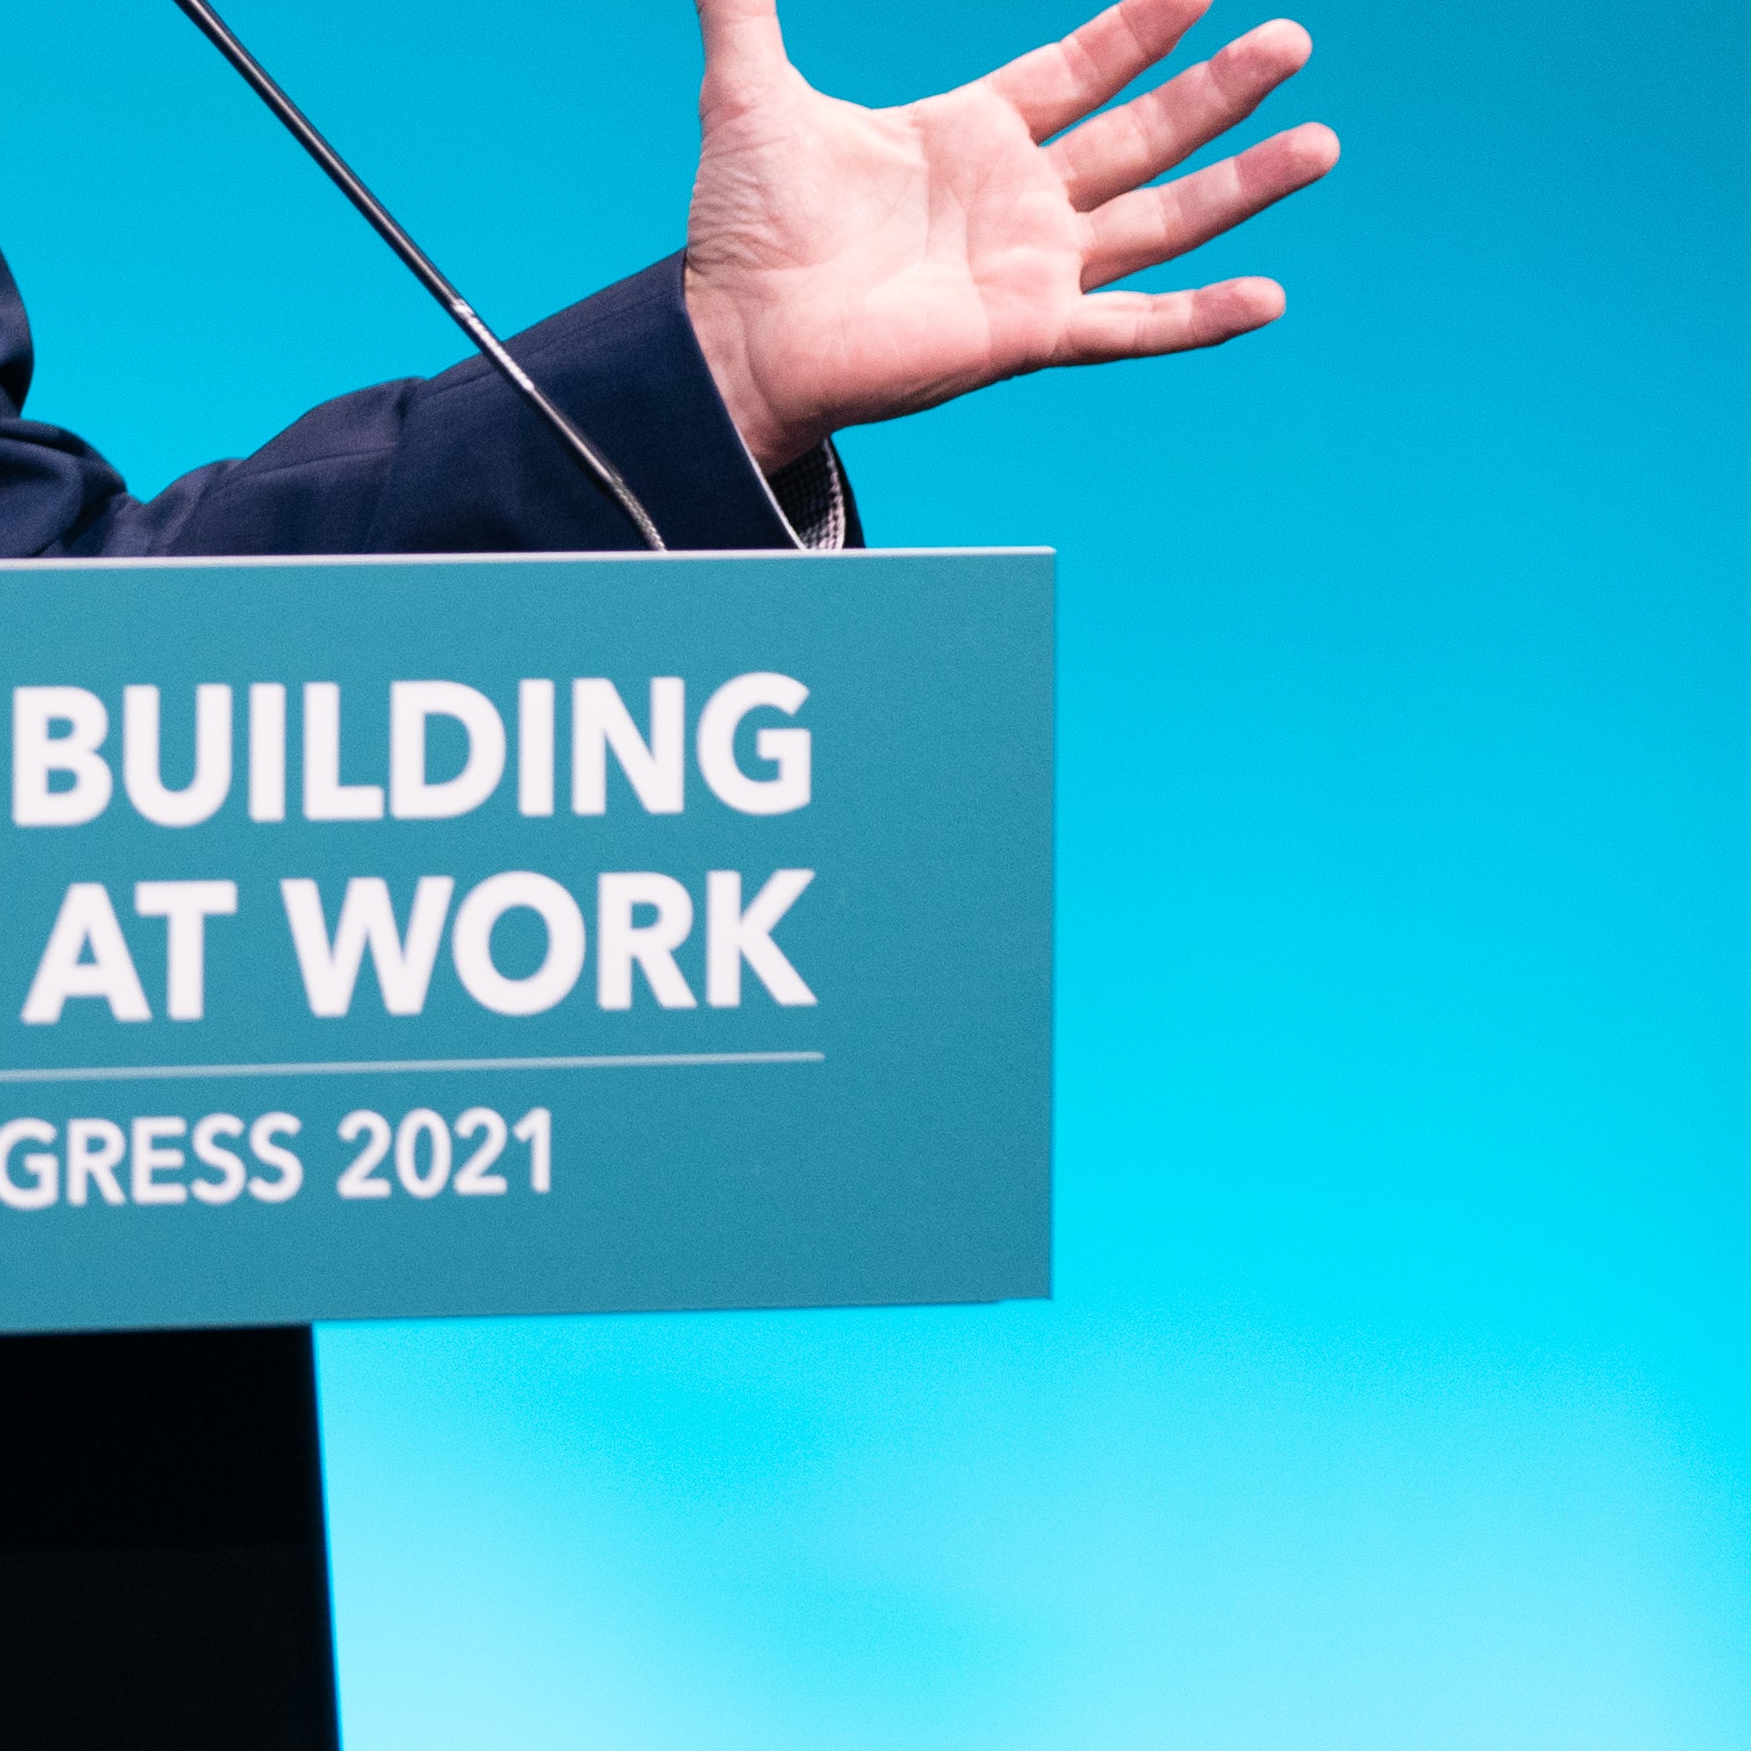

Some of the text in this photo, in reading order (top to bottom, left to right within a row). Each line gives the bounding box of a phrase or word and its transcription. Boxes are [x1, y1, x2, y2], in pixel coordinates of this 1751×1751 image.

[11, 671, 812, 829] BUILDING
[20, 879, 239, 1025] AT
[280, 868, 818, 1018] WORK
[336, 1106, 552, 1199] 2021
